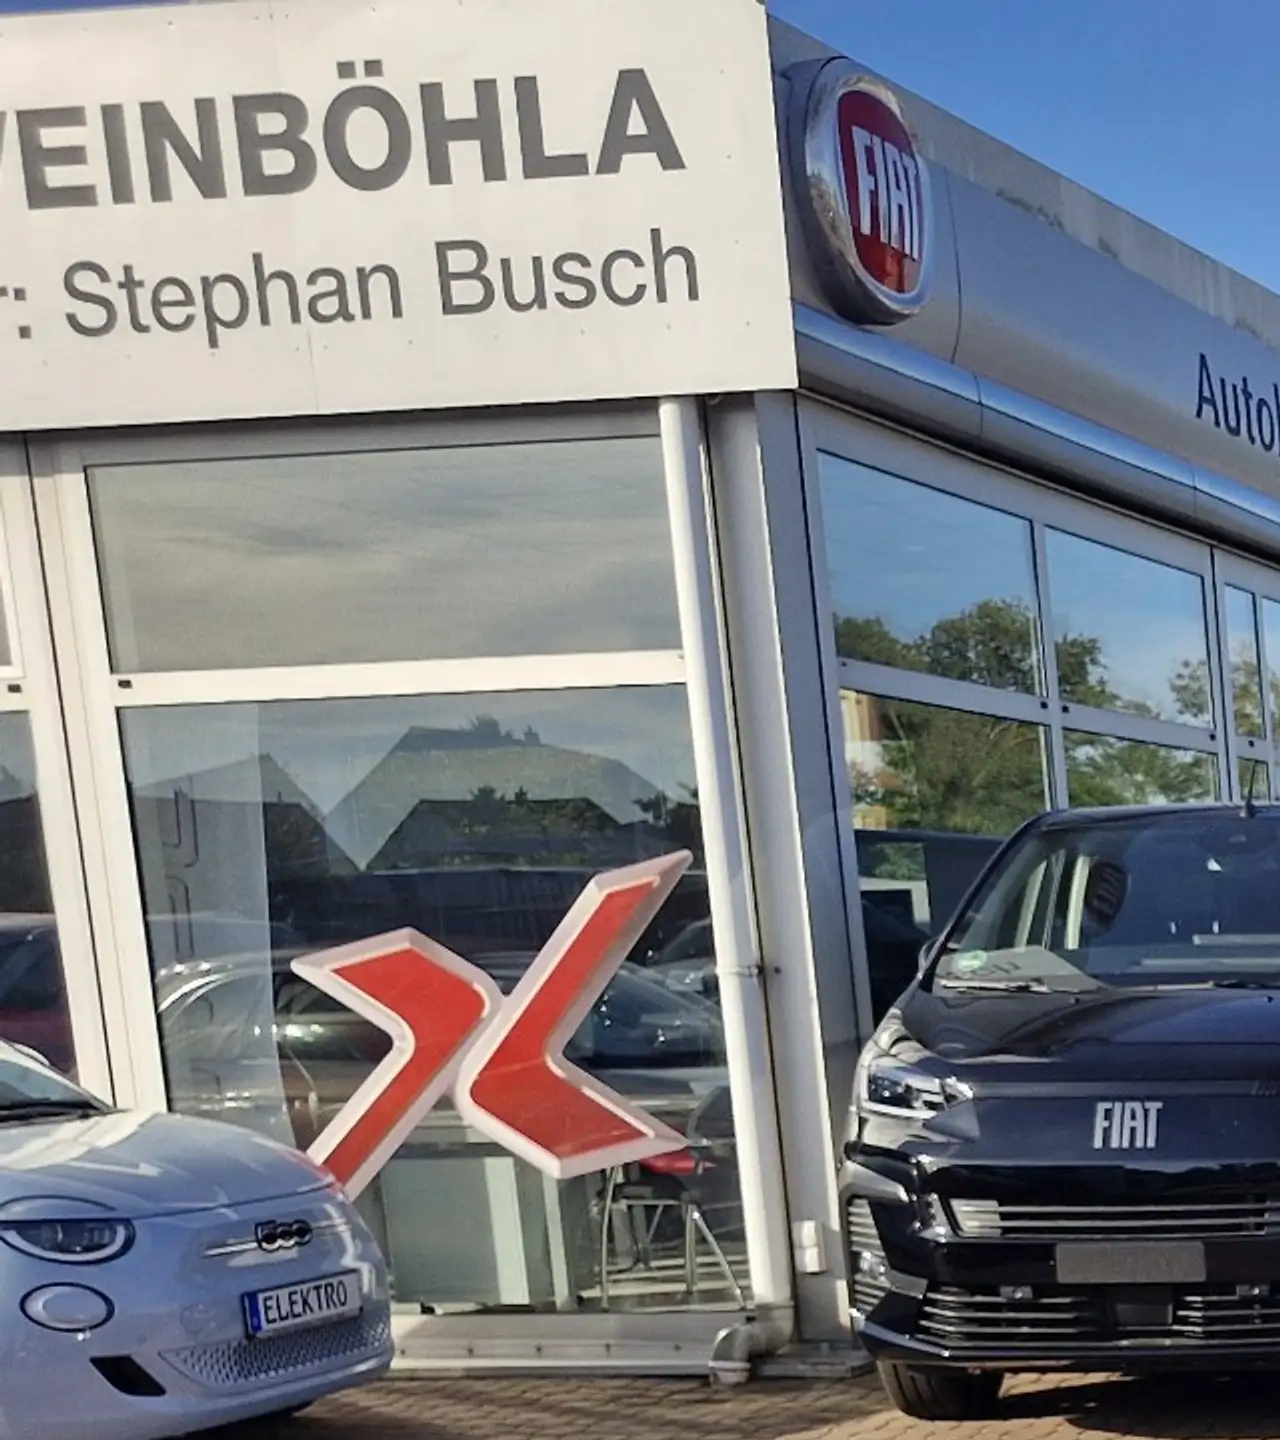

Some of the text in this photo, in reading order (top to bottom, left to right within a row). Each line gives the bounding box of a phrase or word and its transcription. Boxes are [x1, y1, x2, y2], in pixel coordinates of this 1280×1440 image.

[0, 59, 686, 211] EINBÖHLA
[852, 123, 920, 262] FIAT
[63, 253, 403, 348] Stephan
[435, 228, 700, 316] Busch
[1093, 1101, 1163, 1149] FIAT
[263, 1280, 348, 1324] ELEKTRO
